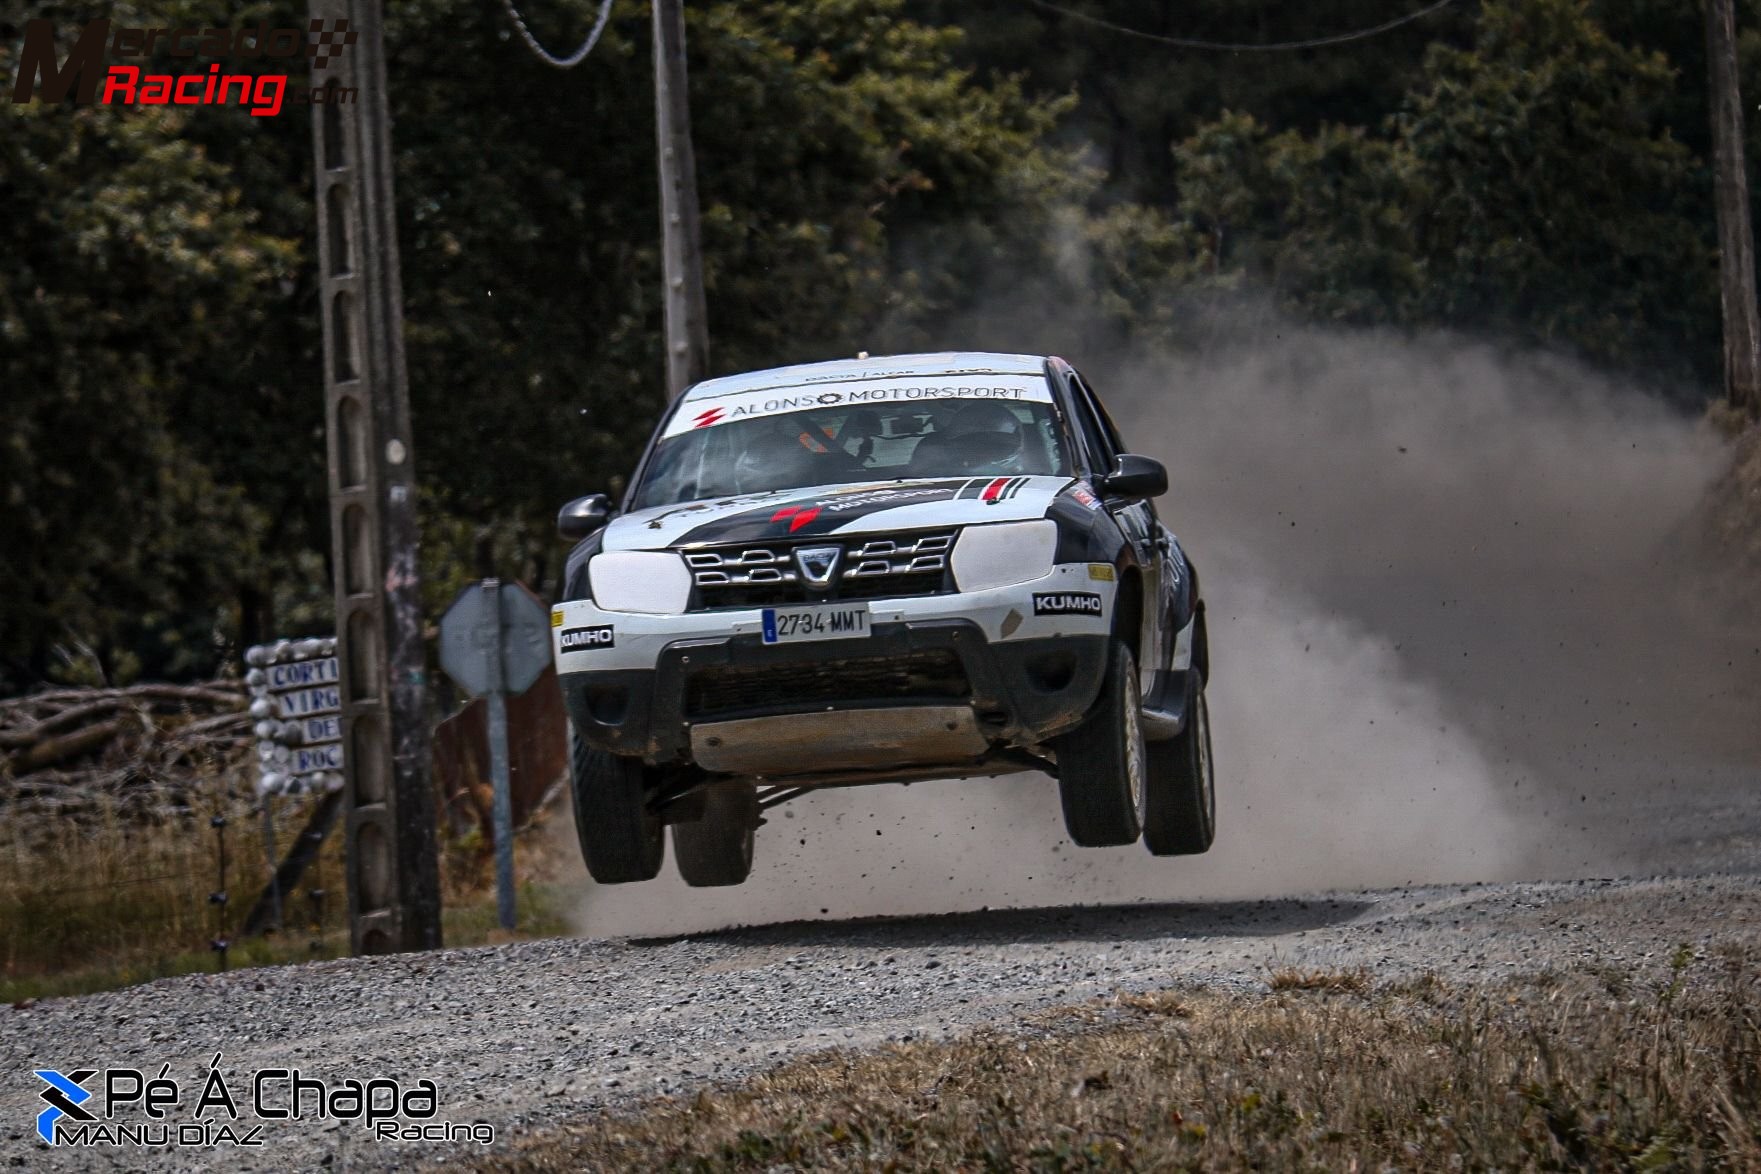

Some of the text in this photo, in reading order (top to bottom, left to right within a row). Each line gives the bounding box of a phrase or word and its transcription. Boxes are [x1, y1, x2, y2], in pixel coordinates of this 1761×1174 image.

[849, 386, 1022, 401] MOTORSPORT
[1036, 595, 1101, 611] KUMHO
[777, 612, 825, 636] 2734
[830, 609, 866, 632] MMT
[562, 629, 613, 647] KUMHO
